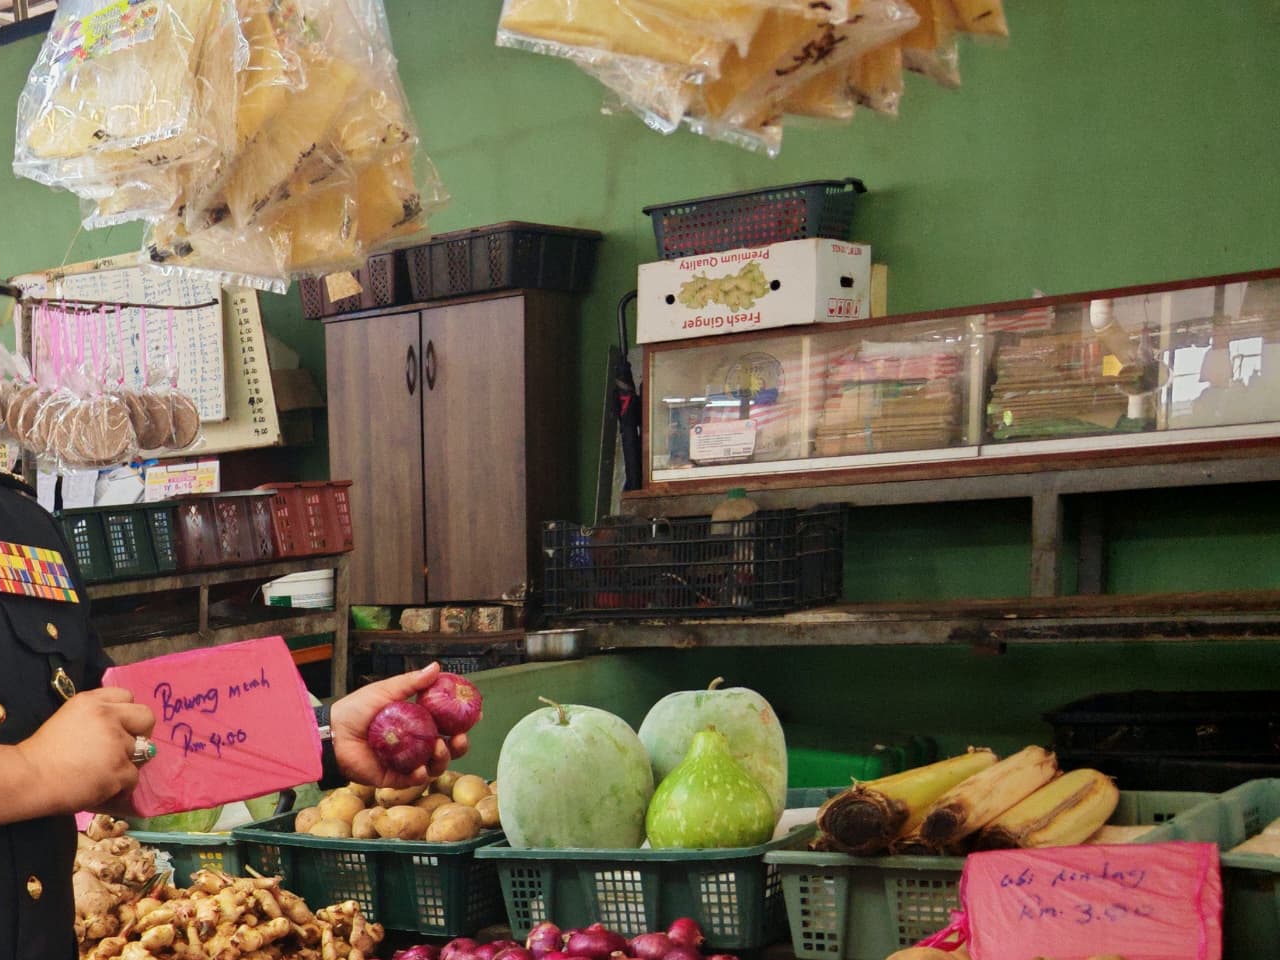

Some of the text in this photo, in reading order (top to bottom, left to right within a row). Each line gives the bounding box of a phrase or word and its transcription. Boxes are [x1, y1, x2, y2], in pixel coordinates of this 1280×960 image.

[679, 248, 770, 271] Premium Quality
[682, 311, 761, 330] Fresh Ginger
